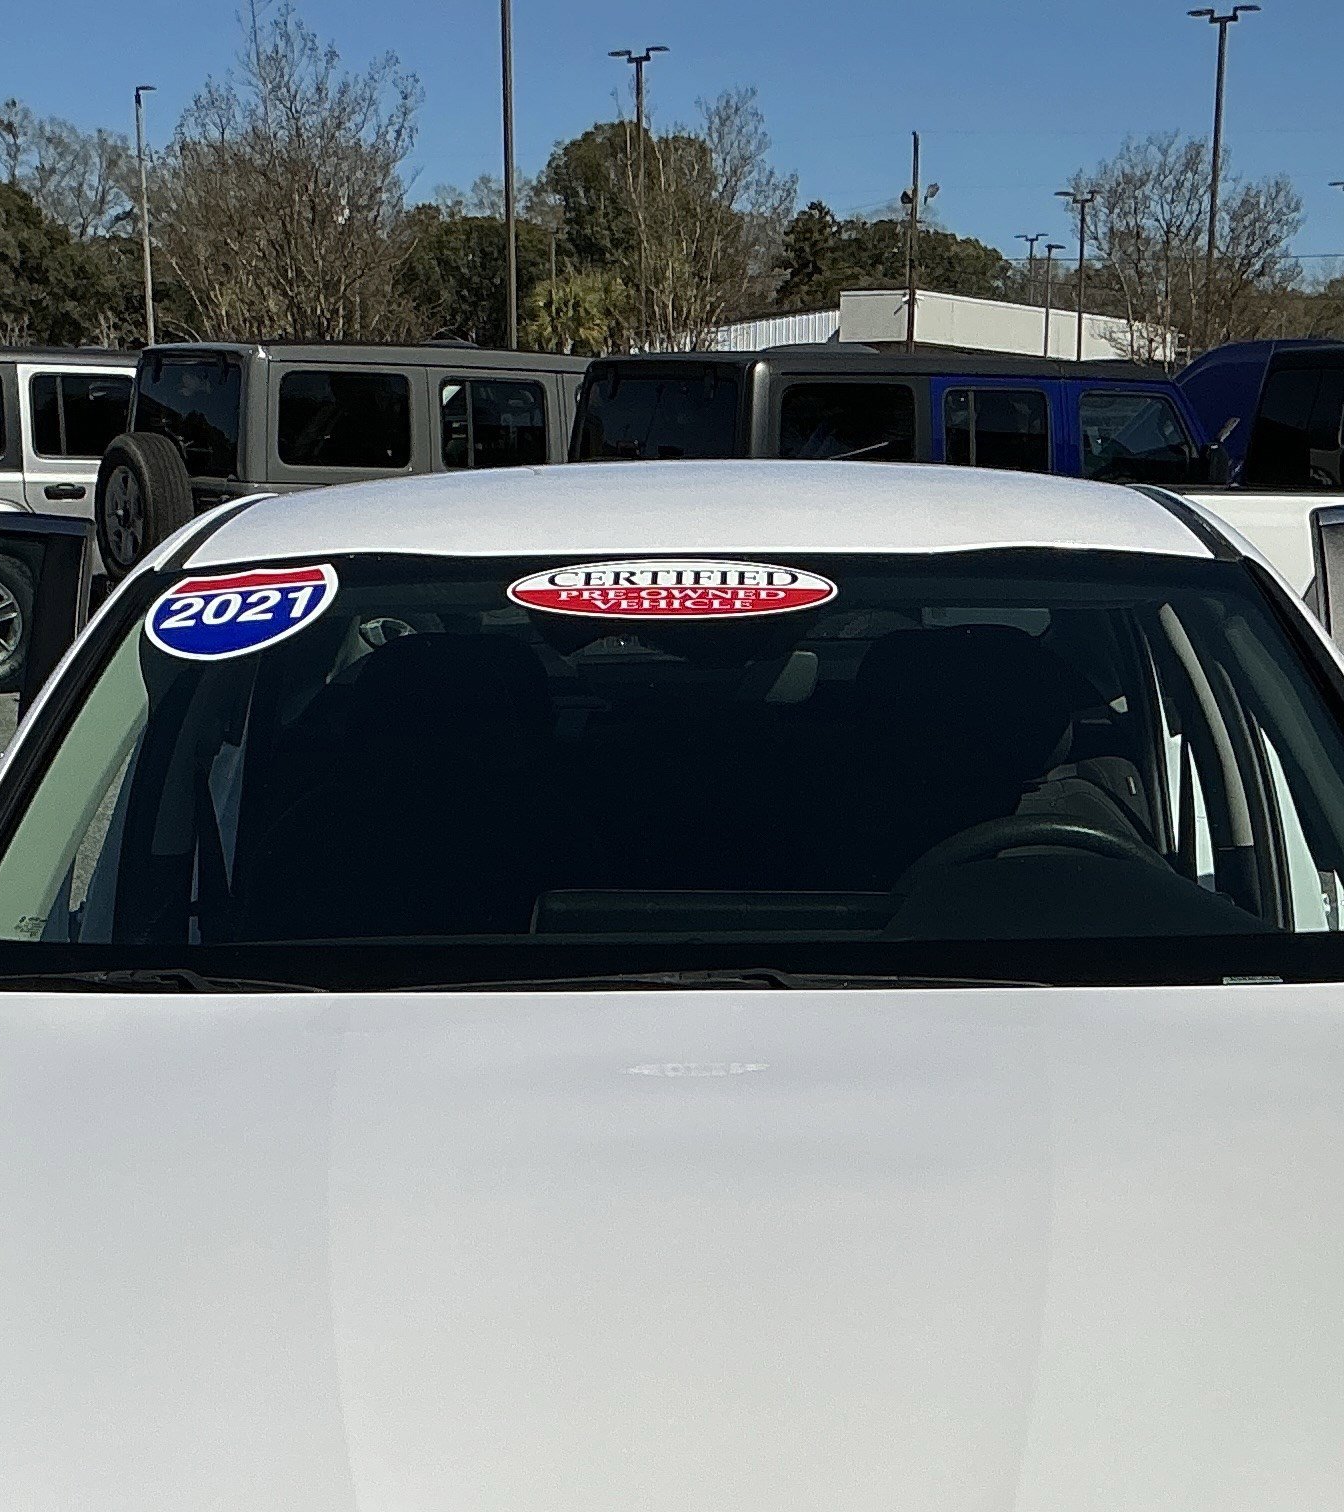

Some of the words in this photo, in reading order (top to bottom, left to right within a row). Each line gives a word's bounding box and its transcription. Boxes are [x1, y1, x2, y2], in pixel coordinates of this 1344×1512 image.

[547, 569, 799, 587] CERTIFIED
[556, 589, 787, 601] PRE-OWNED
[159, 586, 314, 630] 2021
[590, 600, 754, 610] VEHICLE
